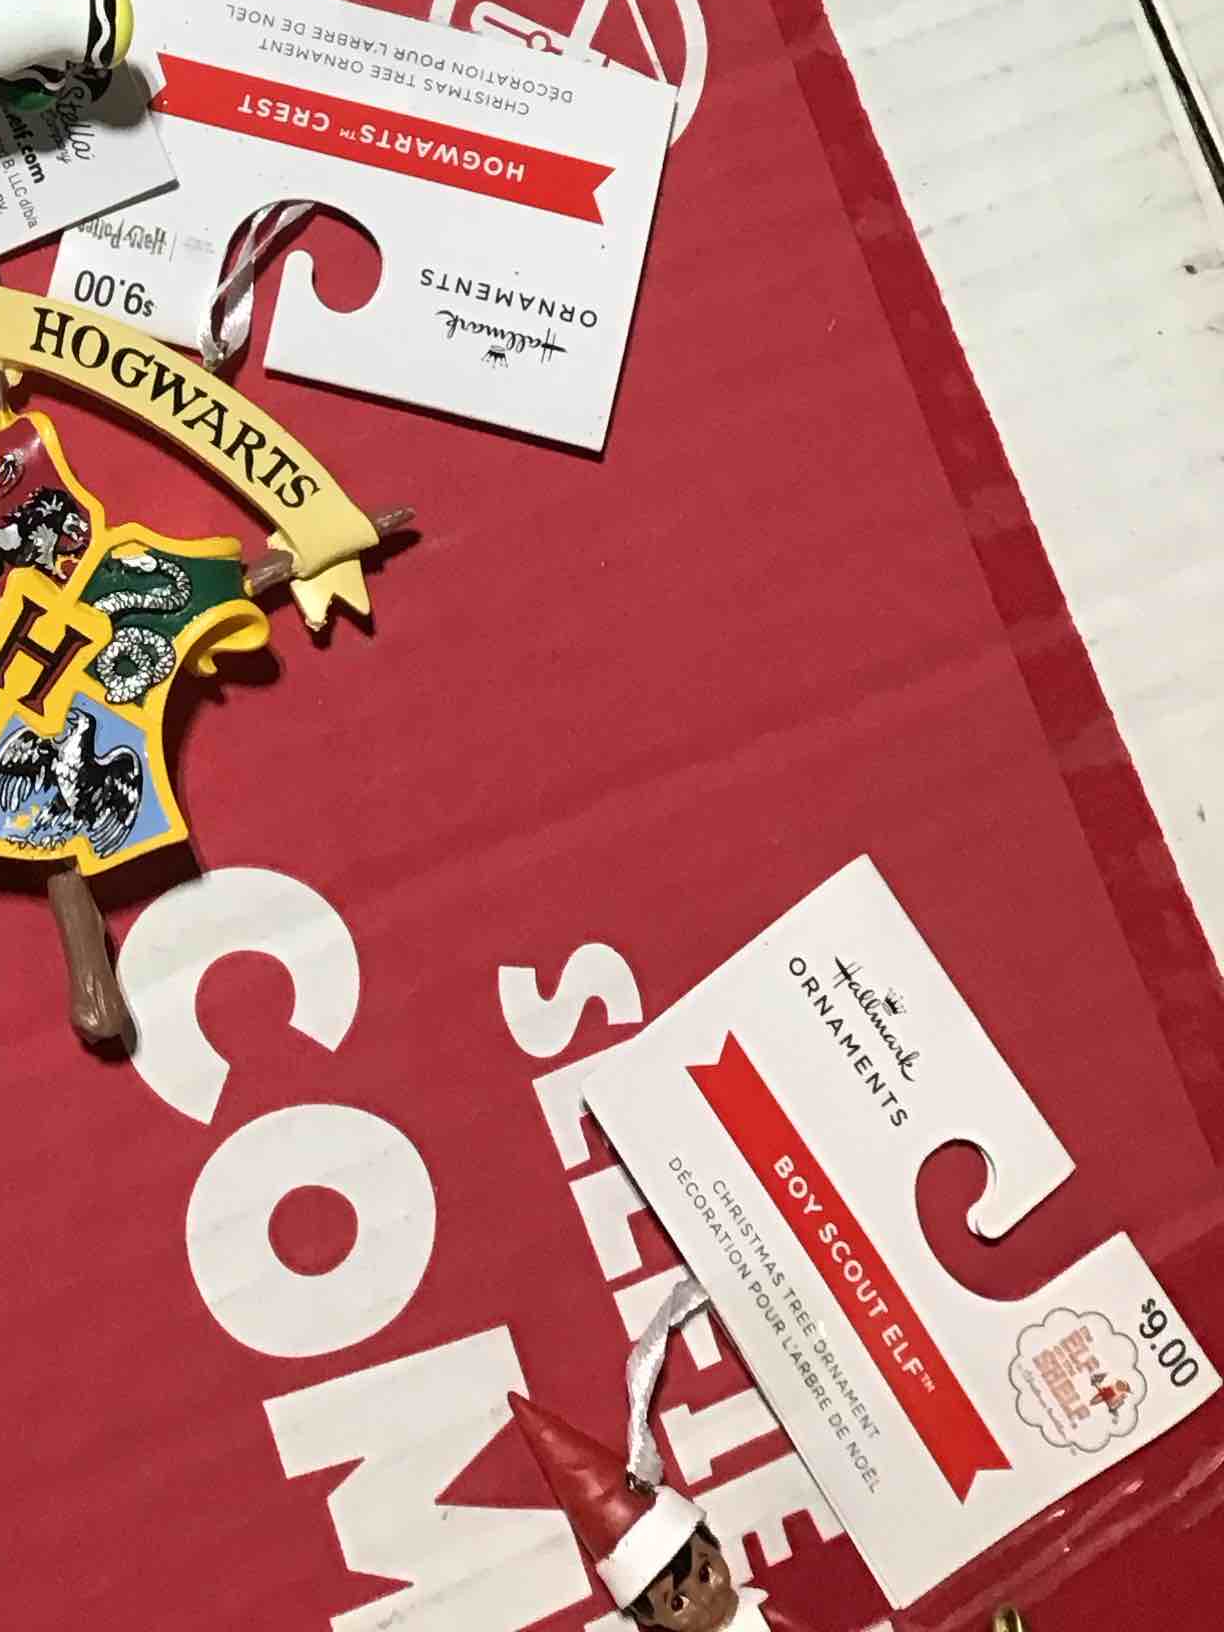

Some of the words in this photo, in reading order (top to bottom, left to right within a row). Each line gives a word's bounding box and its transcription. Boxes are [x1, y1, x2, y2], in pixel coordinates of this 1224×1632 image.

[227, 4, 274, 27] NOËL
[281, 19, 305, 35] DE
[259, 39, 363, 73] ORNAMENT
[312, 27, 387, 56] L'ARBRE
[394, 48, 445, 71] POUR
[371, 65, 415, 88] TREE
[424, 79, 529, 115] CHRISTMAS
[452, 62, 573, 103] DÉCORATION
[238, 95, 329, 131] CREST
[5, 113, 46, 184] elf.com
[8, 173, 27, 197] LLC
[125, 224, 168, 256] Harry
[75, 271, 154, 317] $9.00
[421, 269, 597, 327] ORNAMENTS
[438, 311, 566, 360] Hallmark
[31, 306, 321, 508] HOGWARTS
[834, 957, 919, 1081] Hallmark
[789, 958, 907, 1126] ORNAMENTS
[774, 1156, 822, 1213] BOY
[819, 1223, 888, 1317] SCOUT
[669, 1157, 751, 1280] DÉCORATION
[748, 1281, 785, 1335] POUR
[782, 1337, 831, 1411] L'ARBRE
[828, 1413, 850, 1440] DE
[847, 1442, 879, 1493] NOËL
[713, 1181, 785, 1287] CHRISTMAS
[784, 1288, 816, 1336] TREE
[814, 1340, 880, 1437] ORNAMENT
[1139, 1298, 1199, 1388] $9.00
